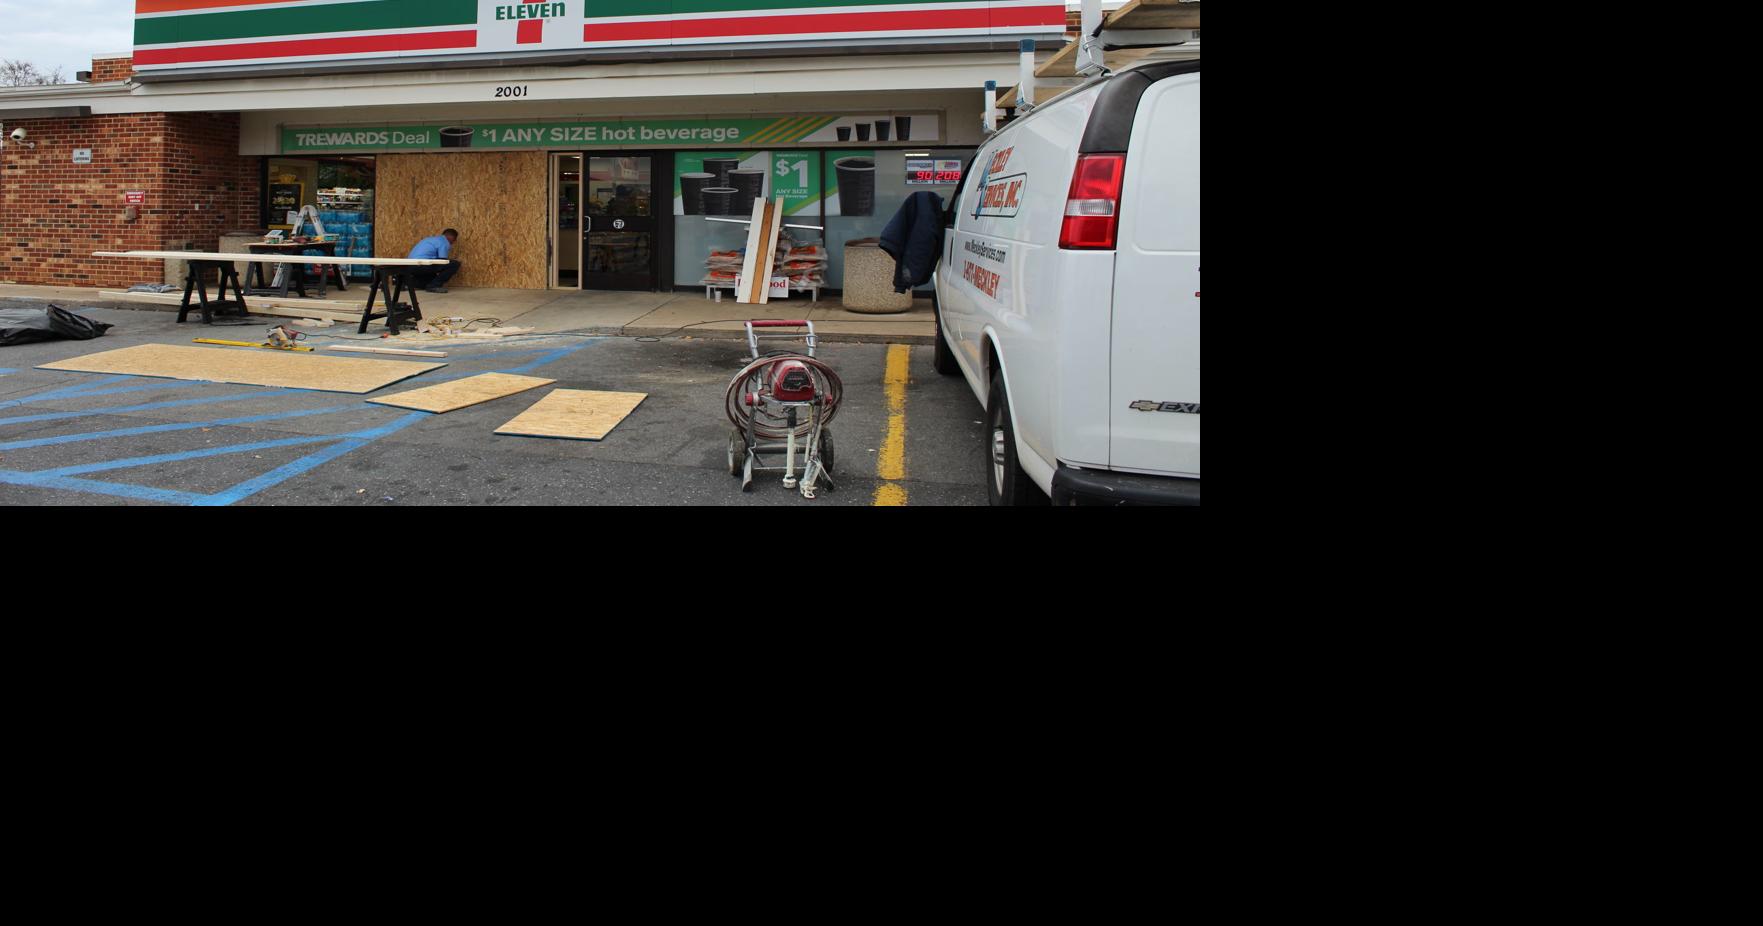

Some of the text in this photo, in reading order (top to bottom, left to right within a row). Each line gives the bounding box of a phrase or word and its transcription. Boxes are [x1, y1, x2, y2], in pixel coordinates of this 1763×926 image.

[495, 85, 527, 97] 2001
[392, 131, 430, 145] Deal
[482, 128, 497, 142] $1
[502, 128, 546, 142] ANY
[550, 127, 597, 141] SIZE
[602, 126, 636, 140] hot
[640, 126, 740, 142] beverage
[775, 158, 808, 188] $1
[916, 171, 933, 180] 90
[935, 171, 961, 180] 208
